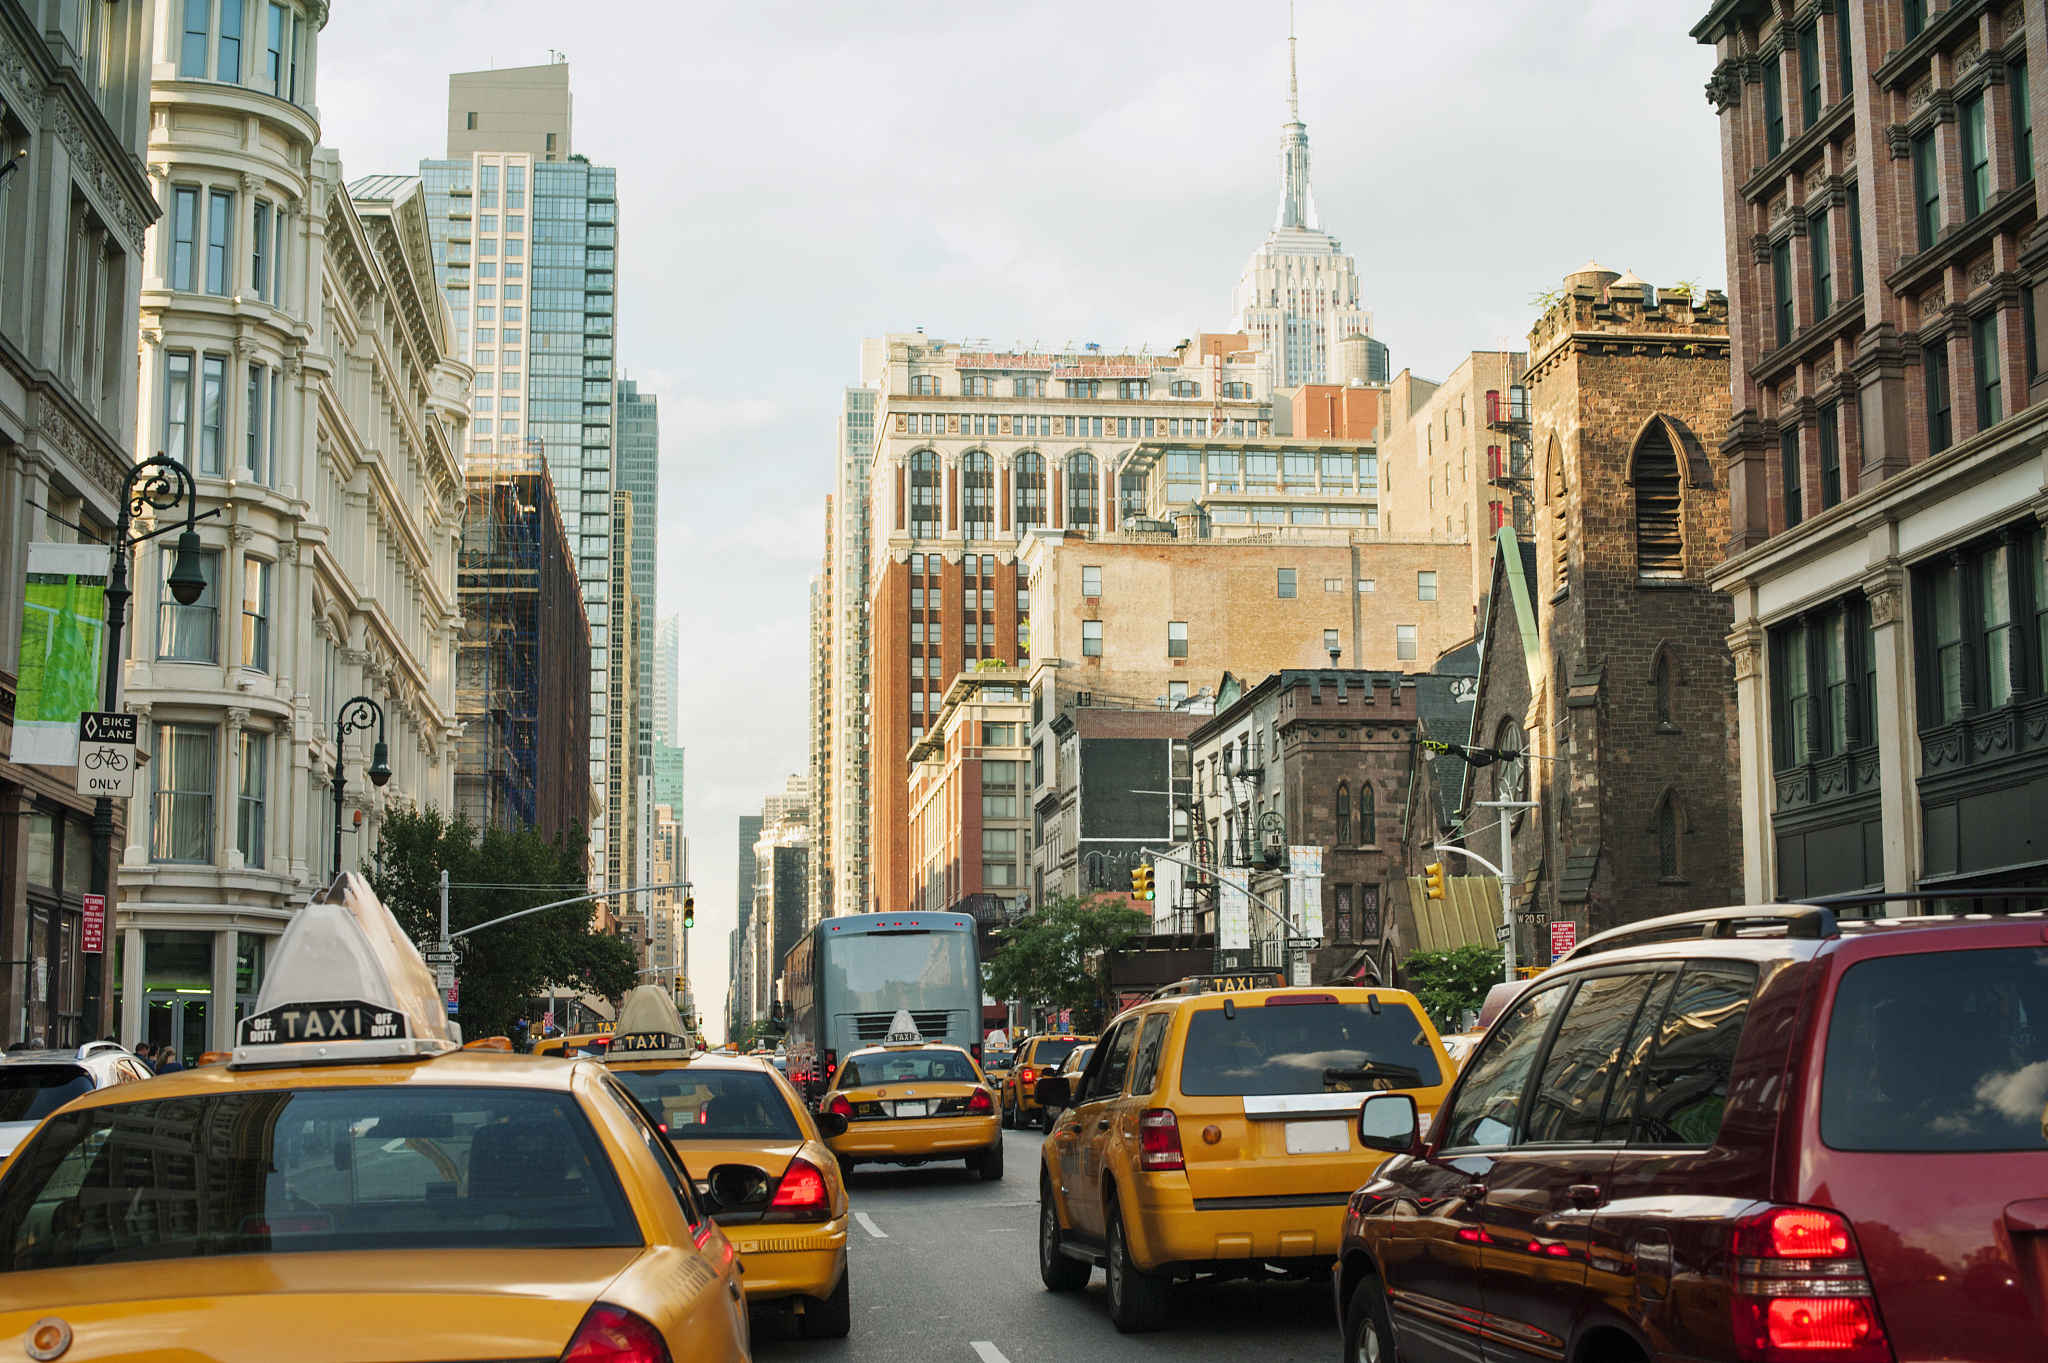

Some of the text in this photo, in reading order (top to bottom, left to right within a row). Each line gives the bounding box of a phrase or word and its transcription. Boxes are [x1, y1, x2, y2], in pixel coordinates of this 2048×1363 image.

[102, 717, 131, 728] BIKE
[98, 728, 133, 739] LANE
[89, 778, 121, 790] ONLY
[1518, 914, 1545, 923] W 20 ST
[1213, 977, 1254, 992] TAXI
[254, 1018, 272, 1030] OFF
[282, 1008, 362, 1038] TAXI
[374, 1013, 392, 1024] OFF
[371, 1024, 397, 1037] DUTY
[598, 1022, 618, 1032] TAX
[250, 1030, 276, 1042] DUTY
[625, 1034, 665, 1049] TAXI
[894, 1033, 912, 1041] TAXI
